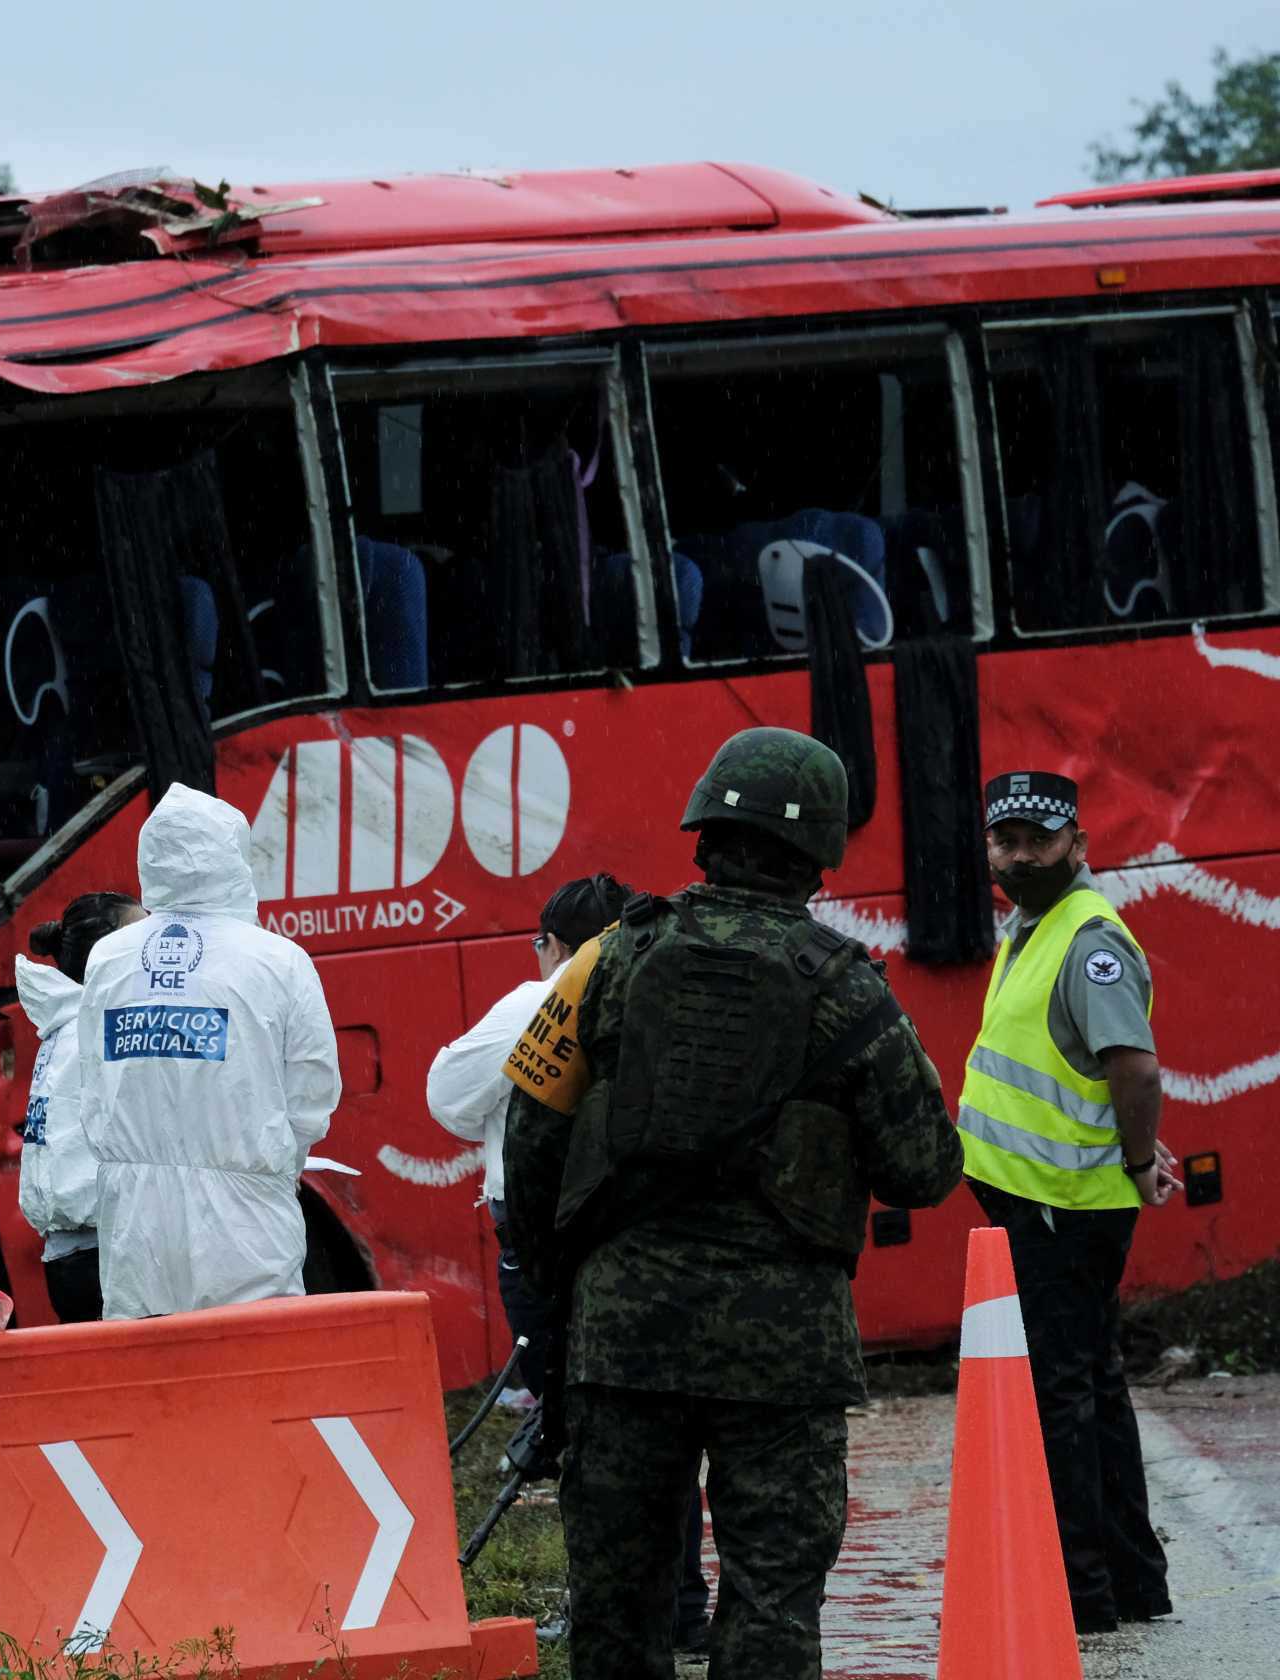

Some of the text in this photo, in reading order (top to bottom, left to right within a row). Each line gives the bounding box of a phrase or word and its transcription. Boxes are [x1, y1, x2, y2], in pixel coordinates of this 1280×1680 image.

[250, 723, 570, 902] ADO
[372, 899, 425, 929] ADO
[150, 970, 186, 989] FGE
[115, 1011, 221, 1033] SERVICIOS
[114, 1033, 219, 1054] PERICIALES
[515, 1039, 562, 1079] CITO
